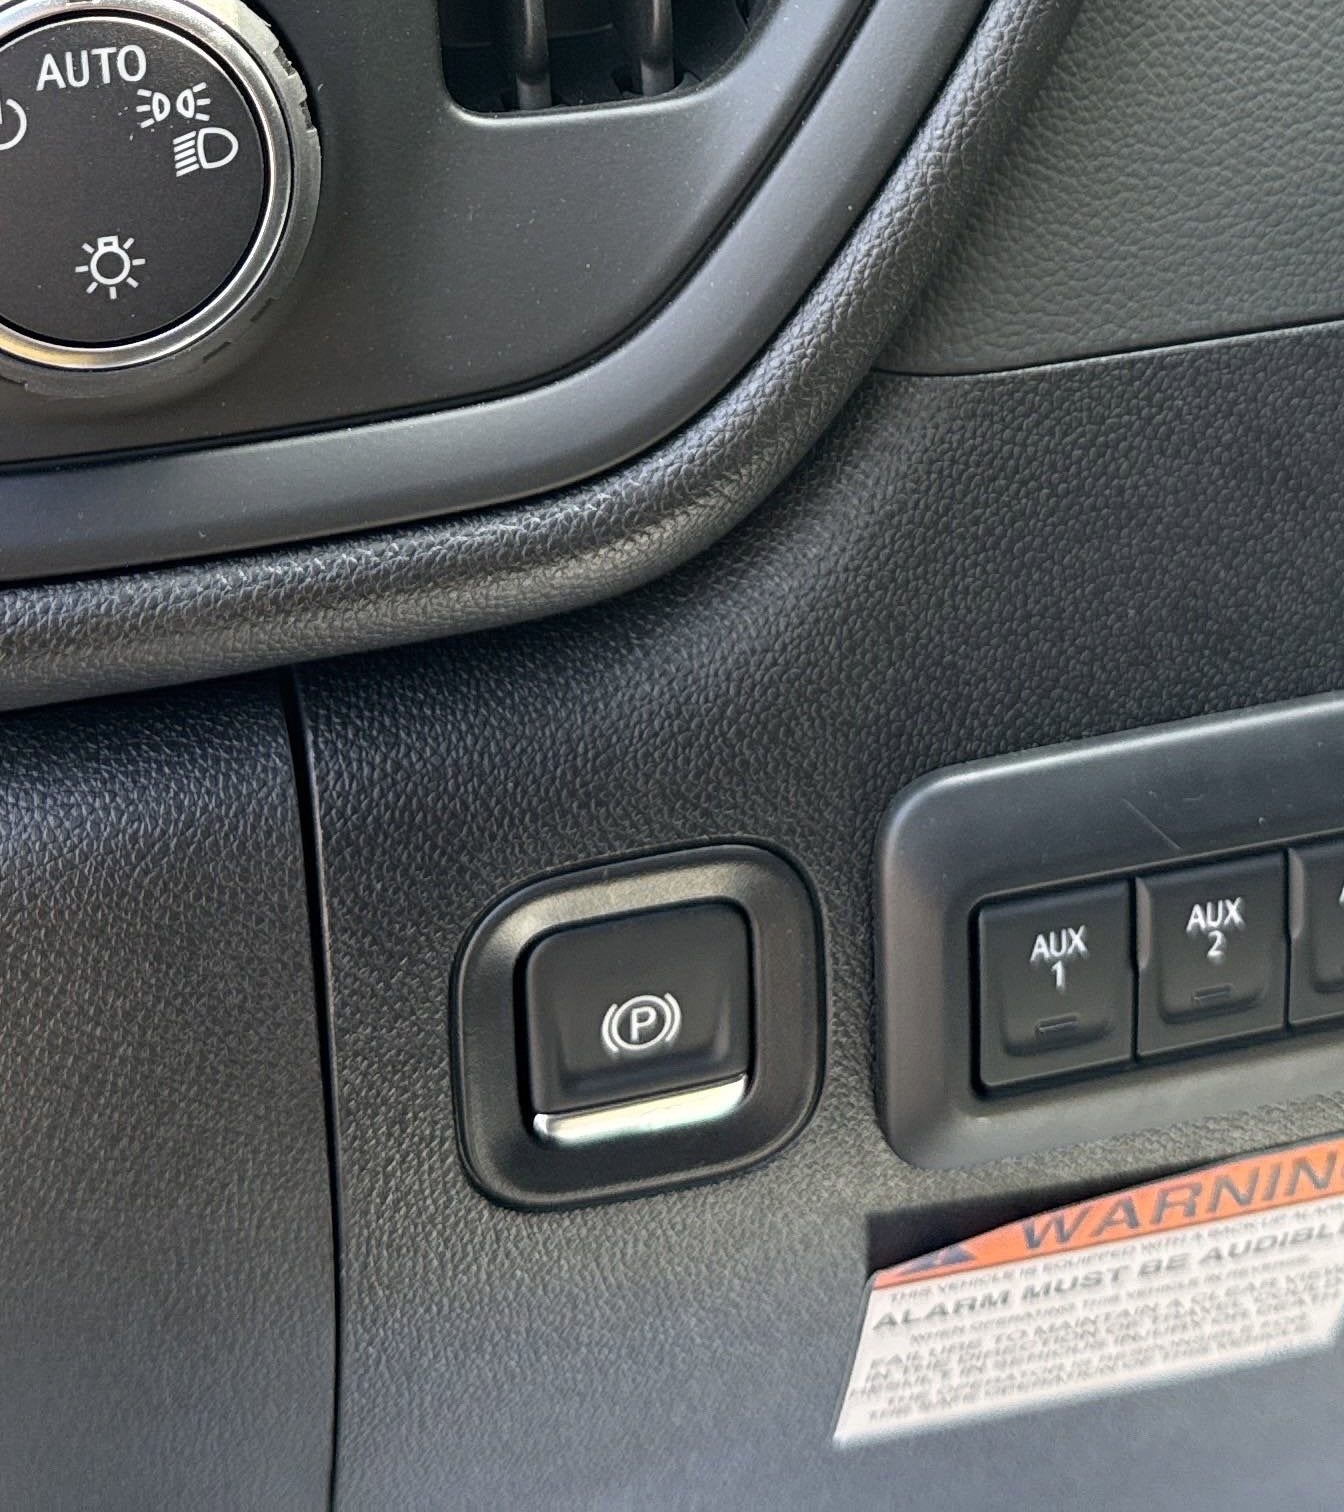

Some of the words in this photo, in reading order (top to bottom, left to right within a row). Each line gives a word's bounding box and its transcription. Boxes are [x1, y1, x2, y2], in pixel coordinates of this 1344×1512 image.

[36, 44, 147, 92] AUTO
[1186, 896, 1246, 934] AUX
[1029, 924, 1089, 963] AUX
[1206, 931, 1228, 962] 2
[1050, 961, 1066, 991] 1
[872, 1288, 1012, 1330] ALARM
[1019, 1264, 1129, 1301] MUST
[1136, 1250, 1192, 1277] BE
